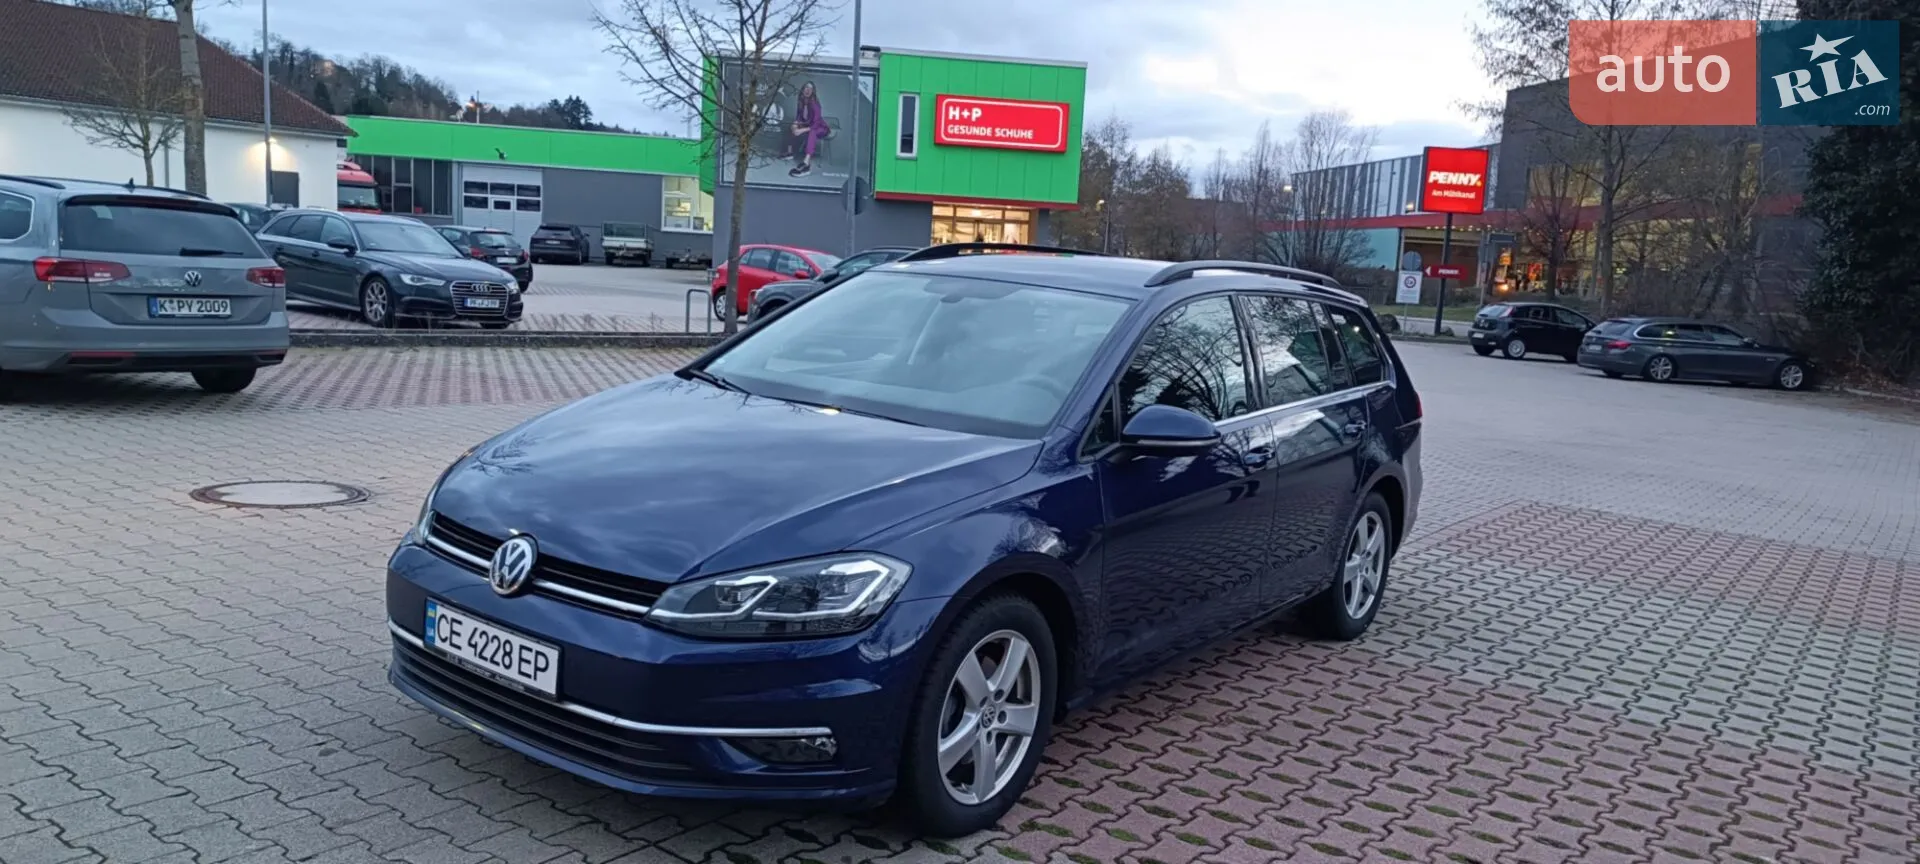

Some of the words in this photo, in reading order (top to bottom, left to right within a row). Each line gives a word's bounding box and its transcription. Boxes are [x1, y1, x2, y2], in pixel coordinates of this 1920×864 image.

[948, 106, 982, 122] H+P
[947, 124, 992, 137] GESUNDE
[994, 127, 1034, 139] SCHUHE
[196, 300, 229, 313] 2009
[437, 613, 463, 651] CE
[467, 627, 513, 670] 4228
[518, 644, 550, 681] EP
